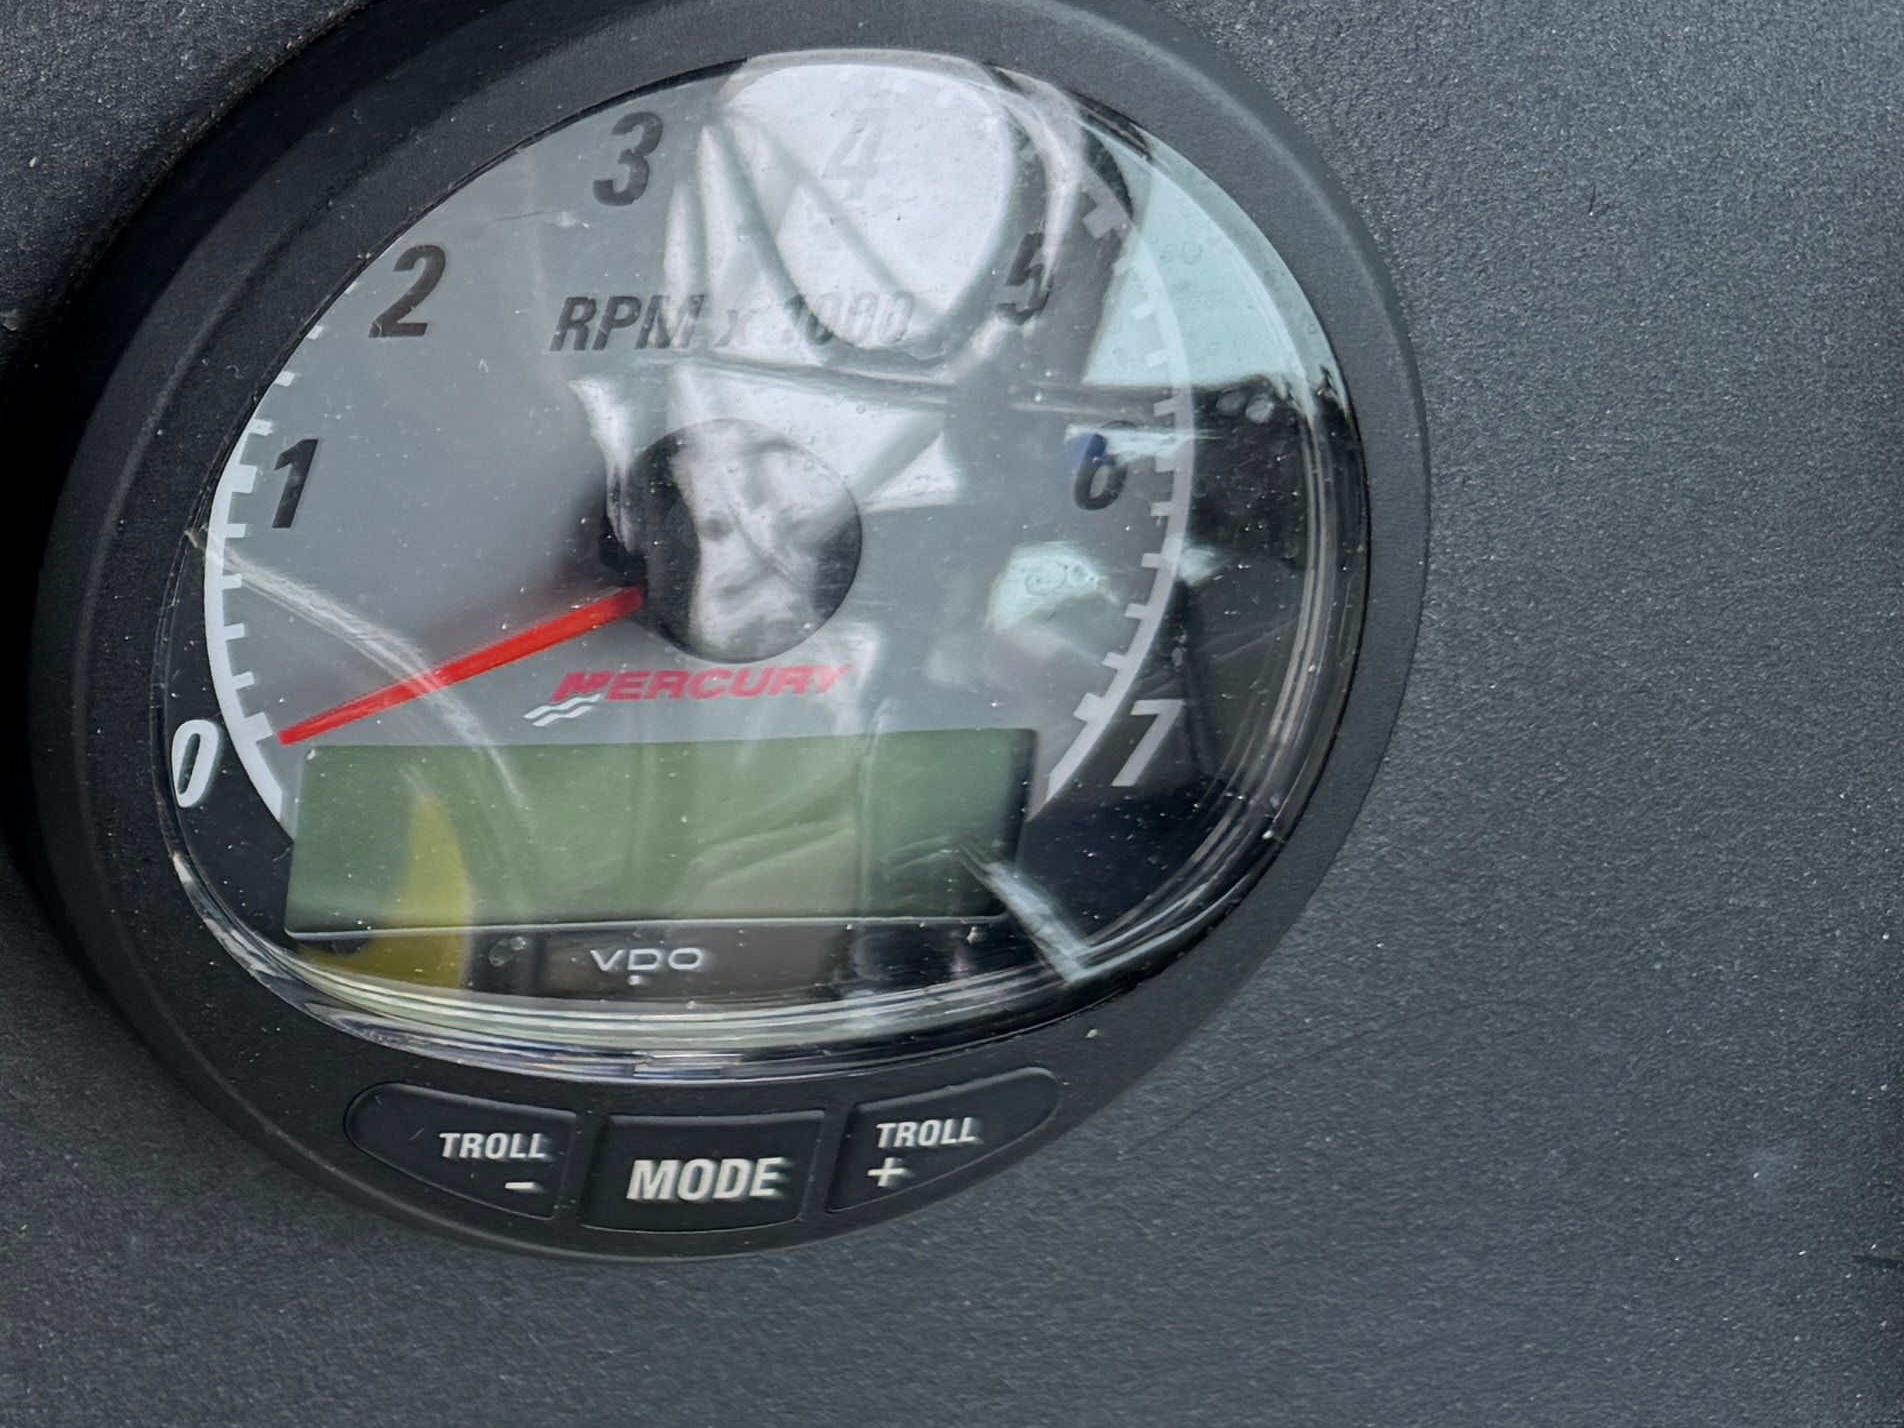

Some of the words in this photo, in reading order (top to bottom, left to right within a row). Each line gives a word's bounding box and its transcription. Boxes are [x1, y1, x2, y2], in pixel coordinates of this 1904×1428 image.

[592, 111, 663, 207] 3
[820, 108, 885, 198] 4
[367, 244, 446, 338] 2
[994, 232, 1053, 324] 5
[549, 294, 708, 352] RPM
[274, 439, 319, 528] 1
[1072, 420, 1130, 511] 6
[550, 663, 850, 701] MERCURY
[170, 719, 219, 807] 0
[1110, 699, 1185, 787] 7
[591, 947, 708, 971] VDO
[440, 1133, 547, 1160] TROLL
[878, 1117, 977, 1147] TROLL
[627, 1157, 785, 1201] MODE
